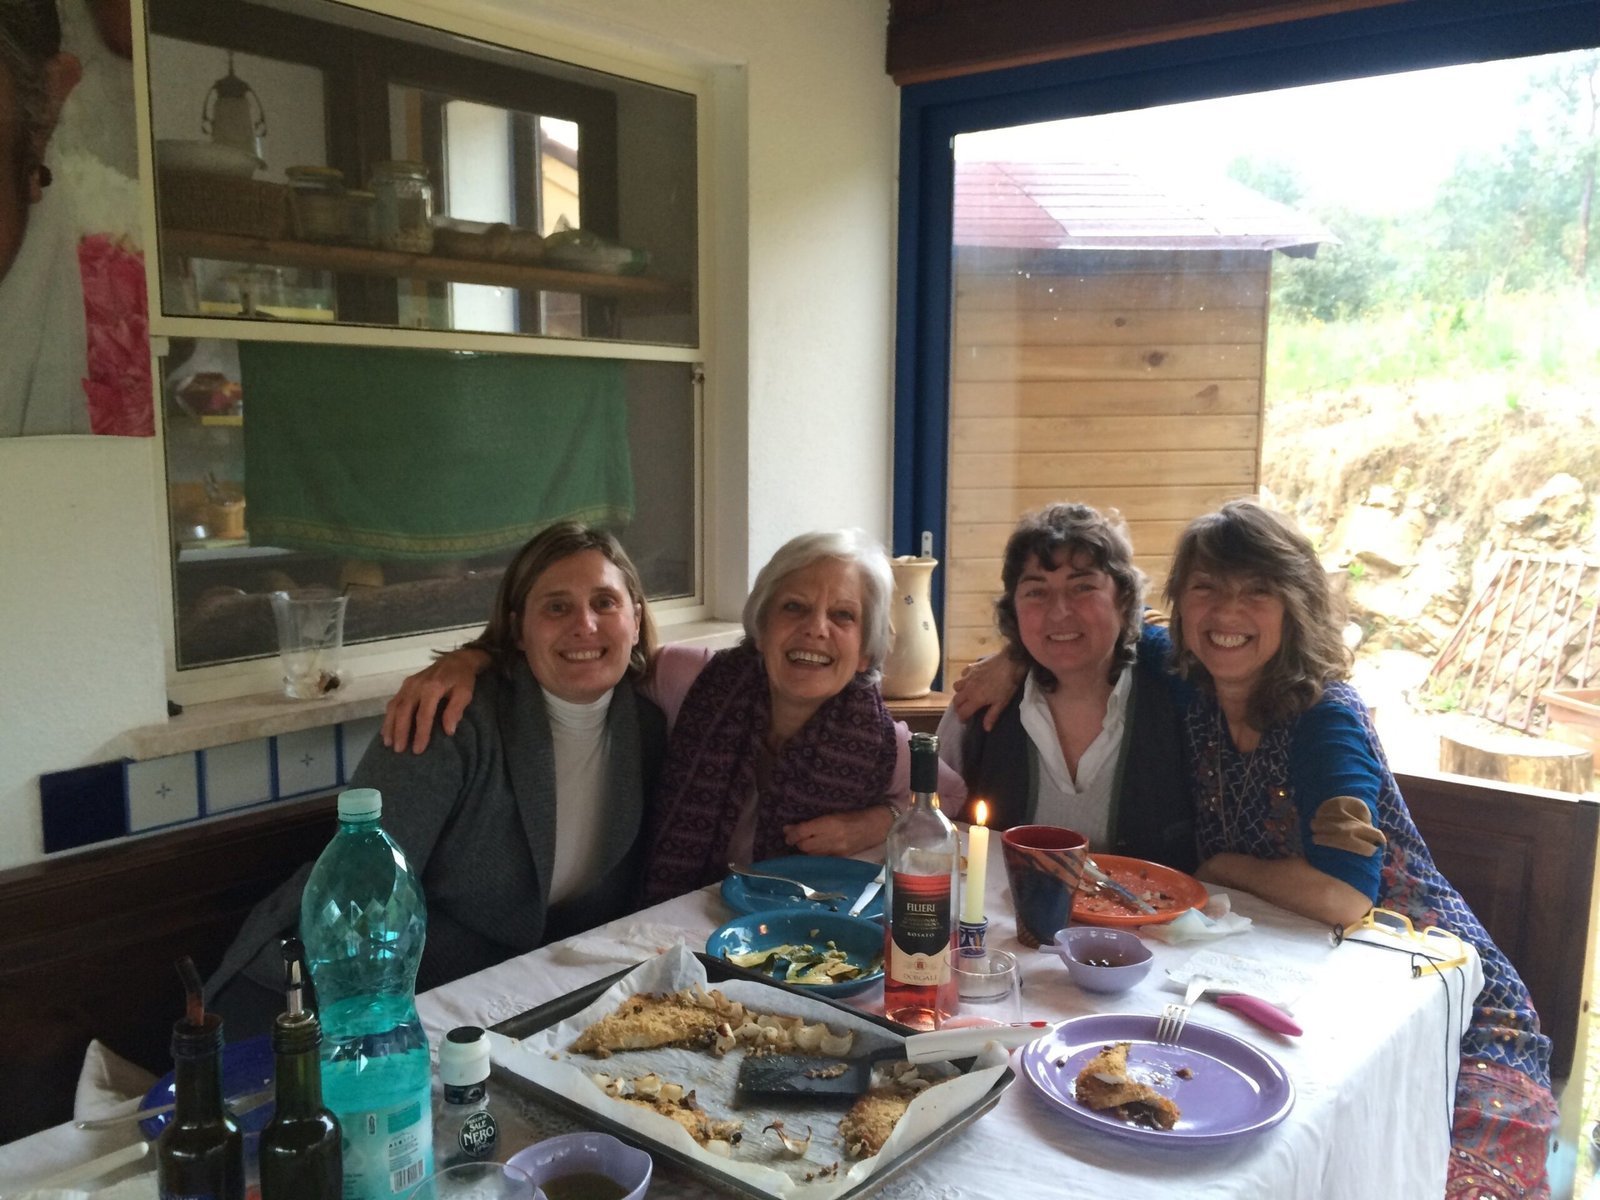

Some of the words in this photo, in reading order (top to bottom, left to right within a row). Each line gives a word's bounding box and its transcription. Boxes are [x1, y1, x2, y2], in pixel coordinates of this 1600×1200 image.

[906, 902, 936, 913] FILIERI
[469, 1120, 488, 1132] SALE
[463, 1126, 494, 1146] NERO
